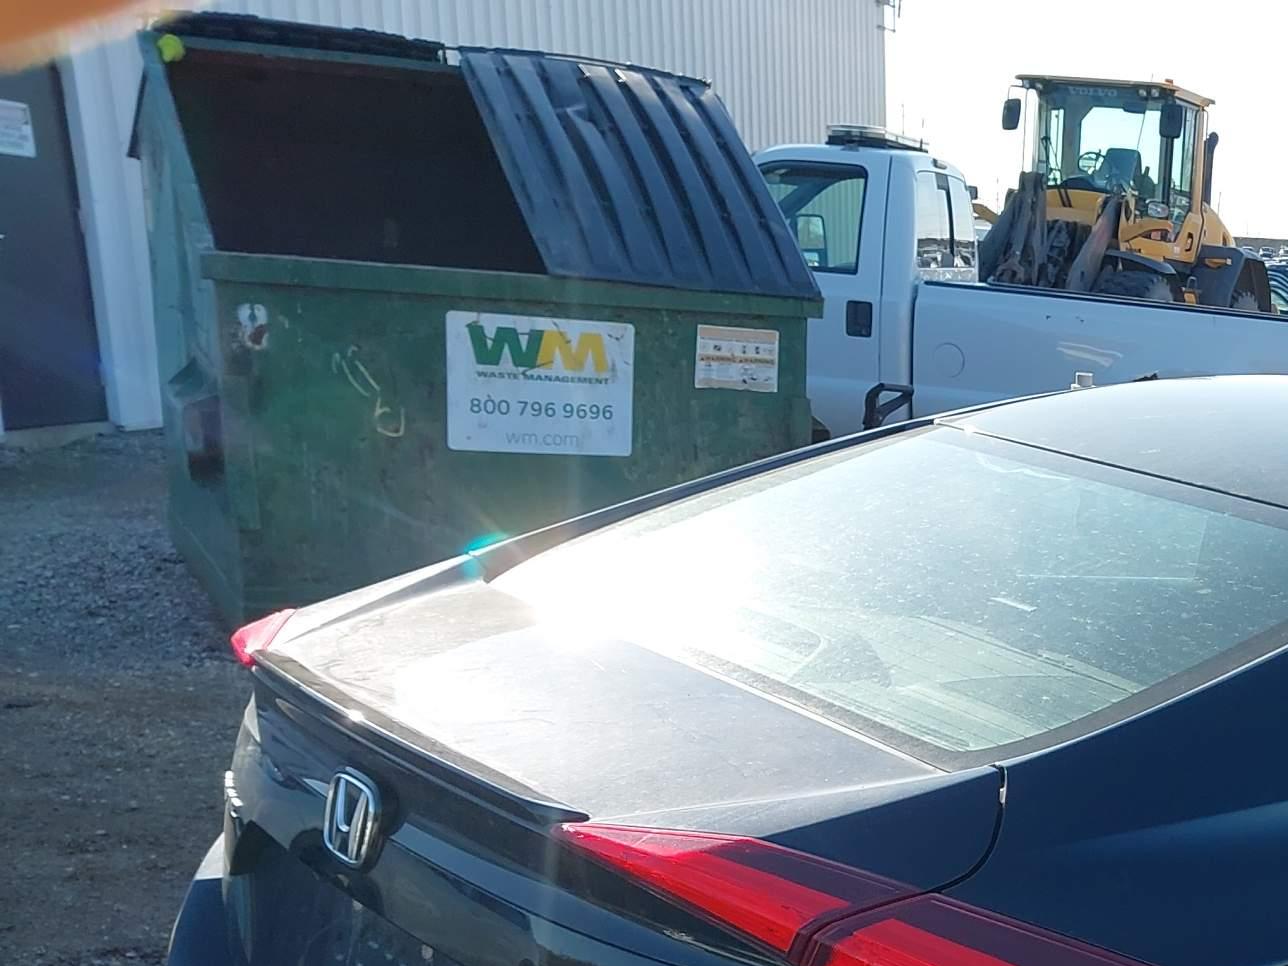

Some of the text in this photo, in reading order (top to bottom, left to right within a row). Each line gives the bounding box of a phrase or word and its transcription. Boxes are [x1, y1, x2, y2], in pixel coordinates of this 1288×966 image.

[1067, 86, 1118, 97] VOLVO
[466, 322, 609, 374] WM
[476, 370, 609, 385] WASTE MANAGEMENT
[469, 397, 614, 420] 800 796 9696
[505, 431, 579, 447] wm.com
